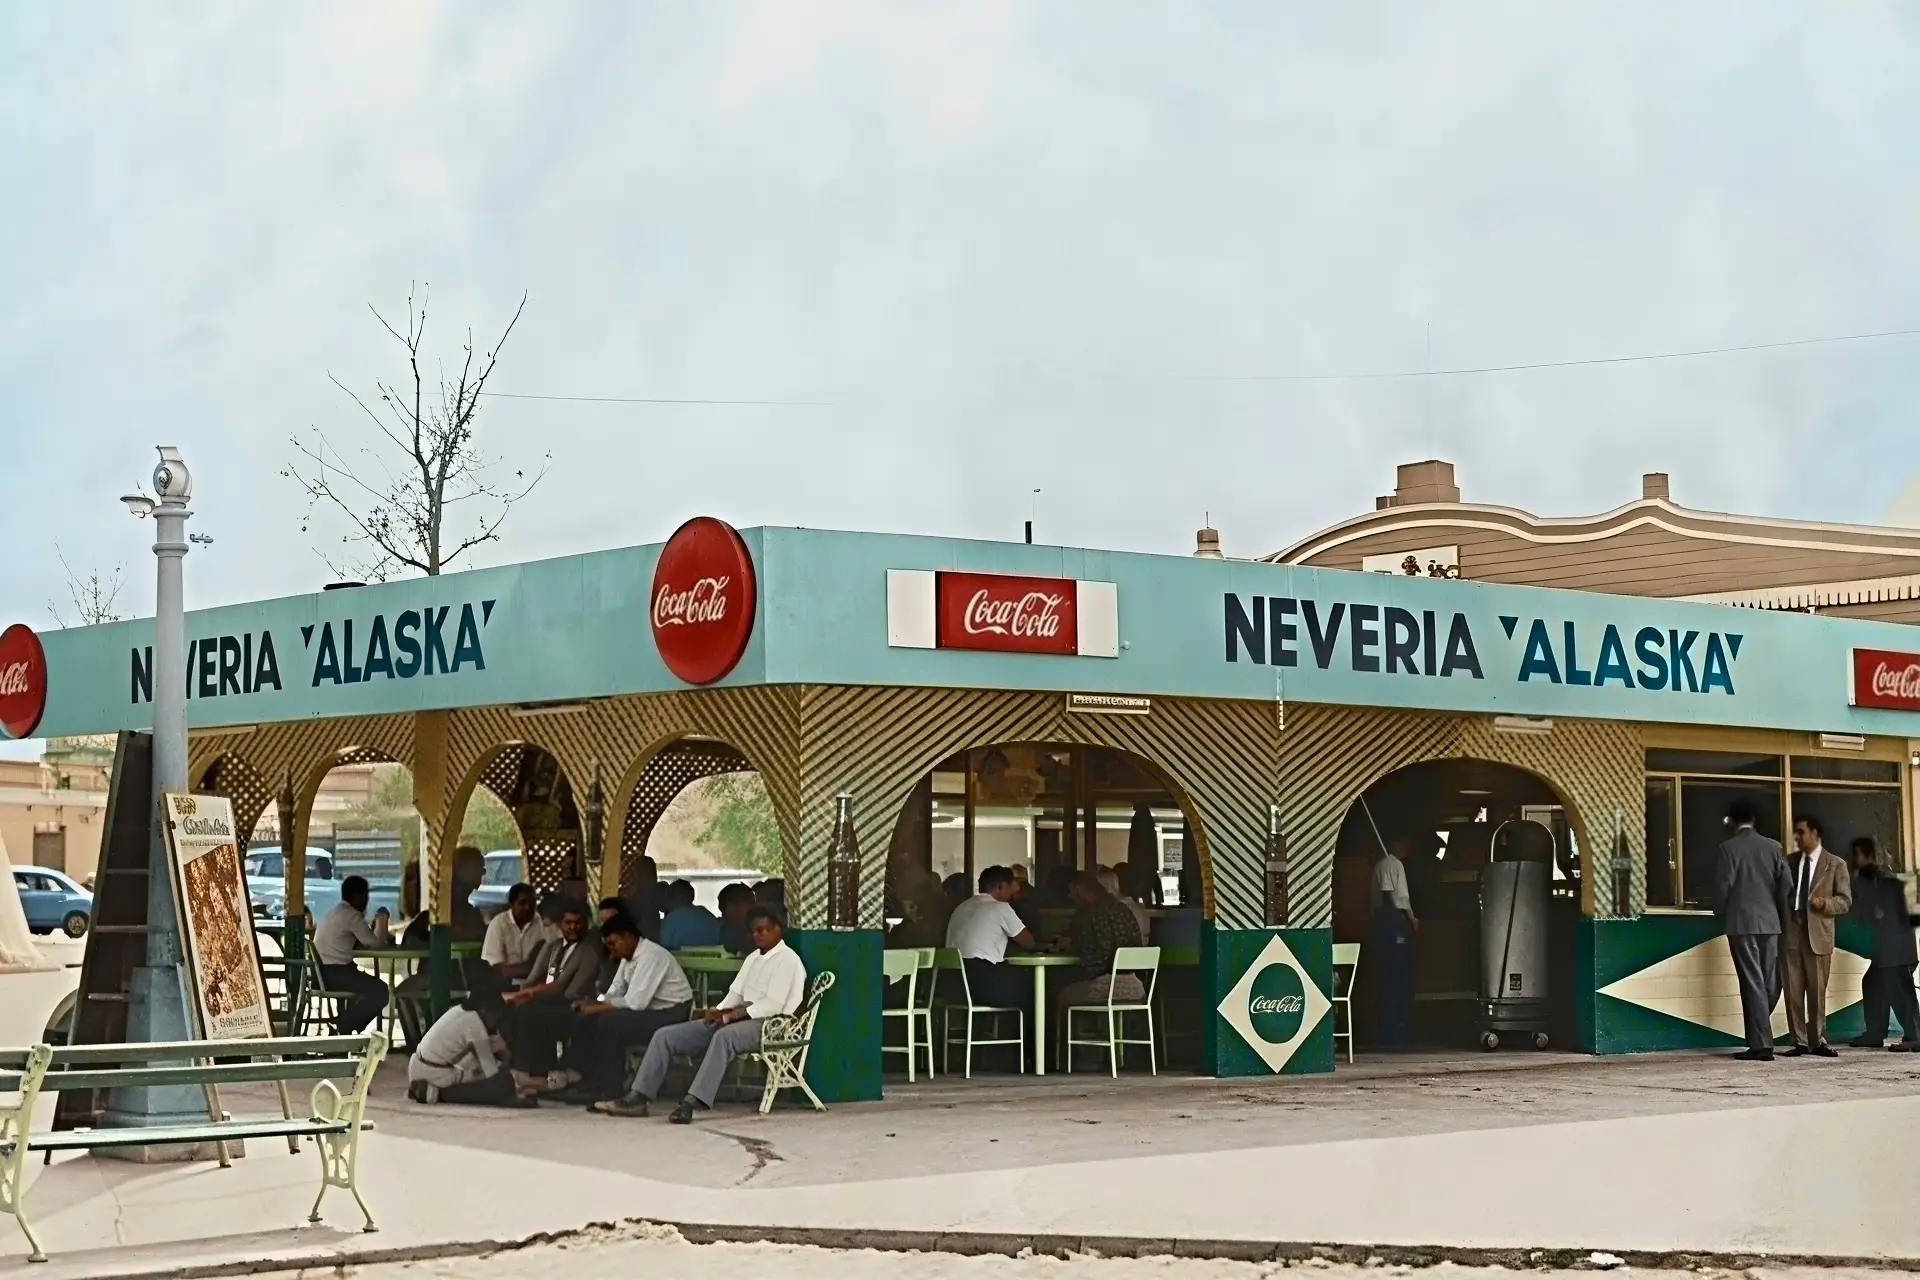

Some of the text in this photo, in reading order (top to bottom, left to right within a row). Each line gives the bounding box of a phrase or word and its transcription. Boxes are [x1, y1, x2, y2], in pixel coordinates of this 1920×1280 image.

[654, 576, 730, 628] Coca-Cola
[964, 589, 1064, 637] Coca-Cola
[1224, 592, 1485, 680] NEVERIA
[131, 630, 283, 704] NERIA
[1250, 995, 1304, 1014] Coca-Cola
